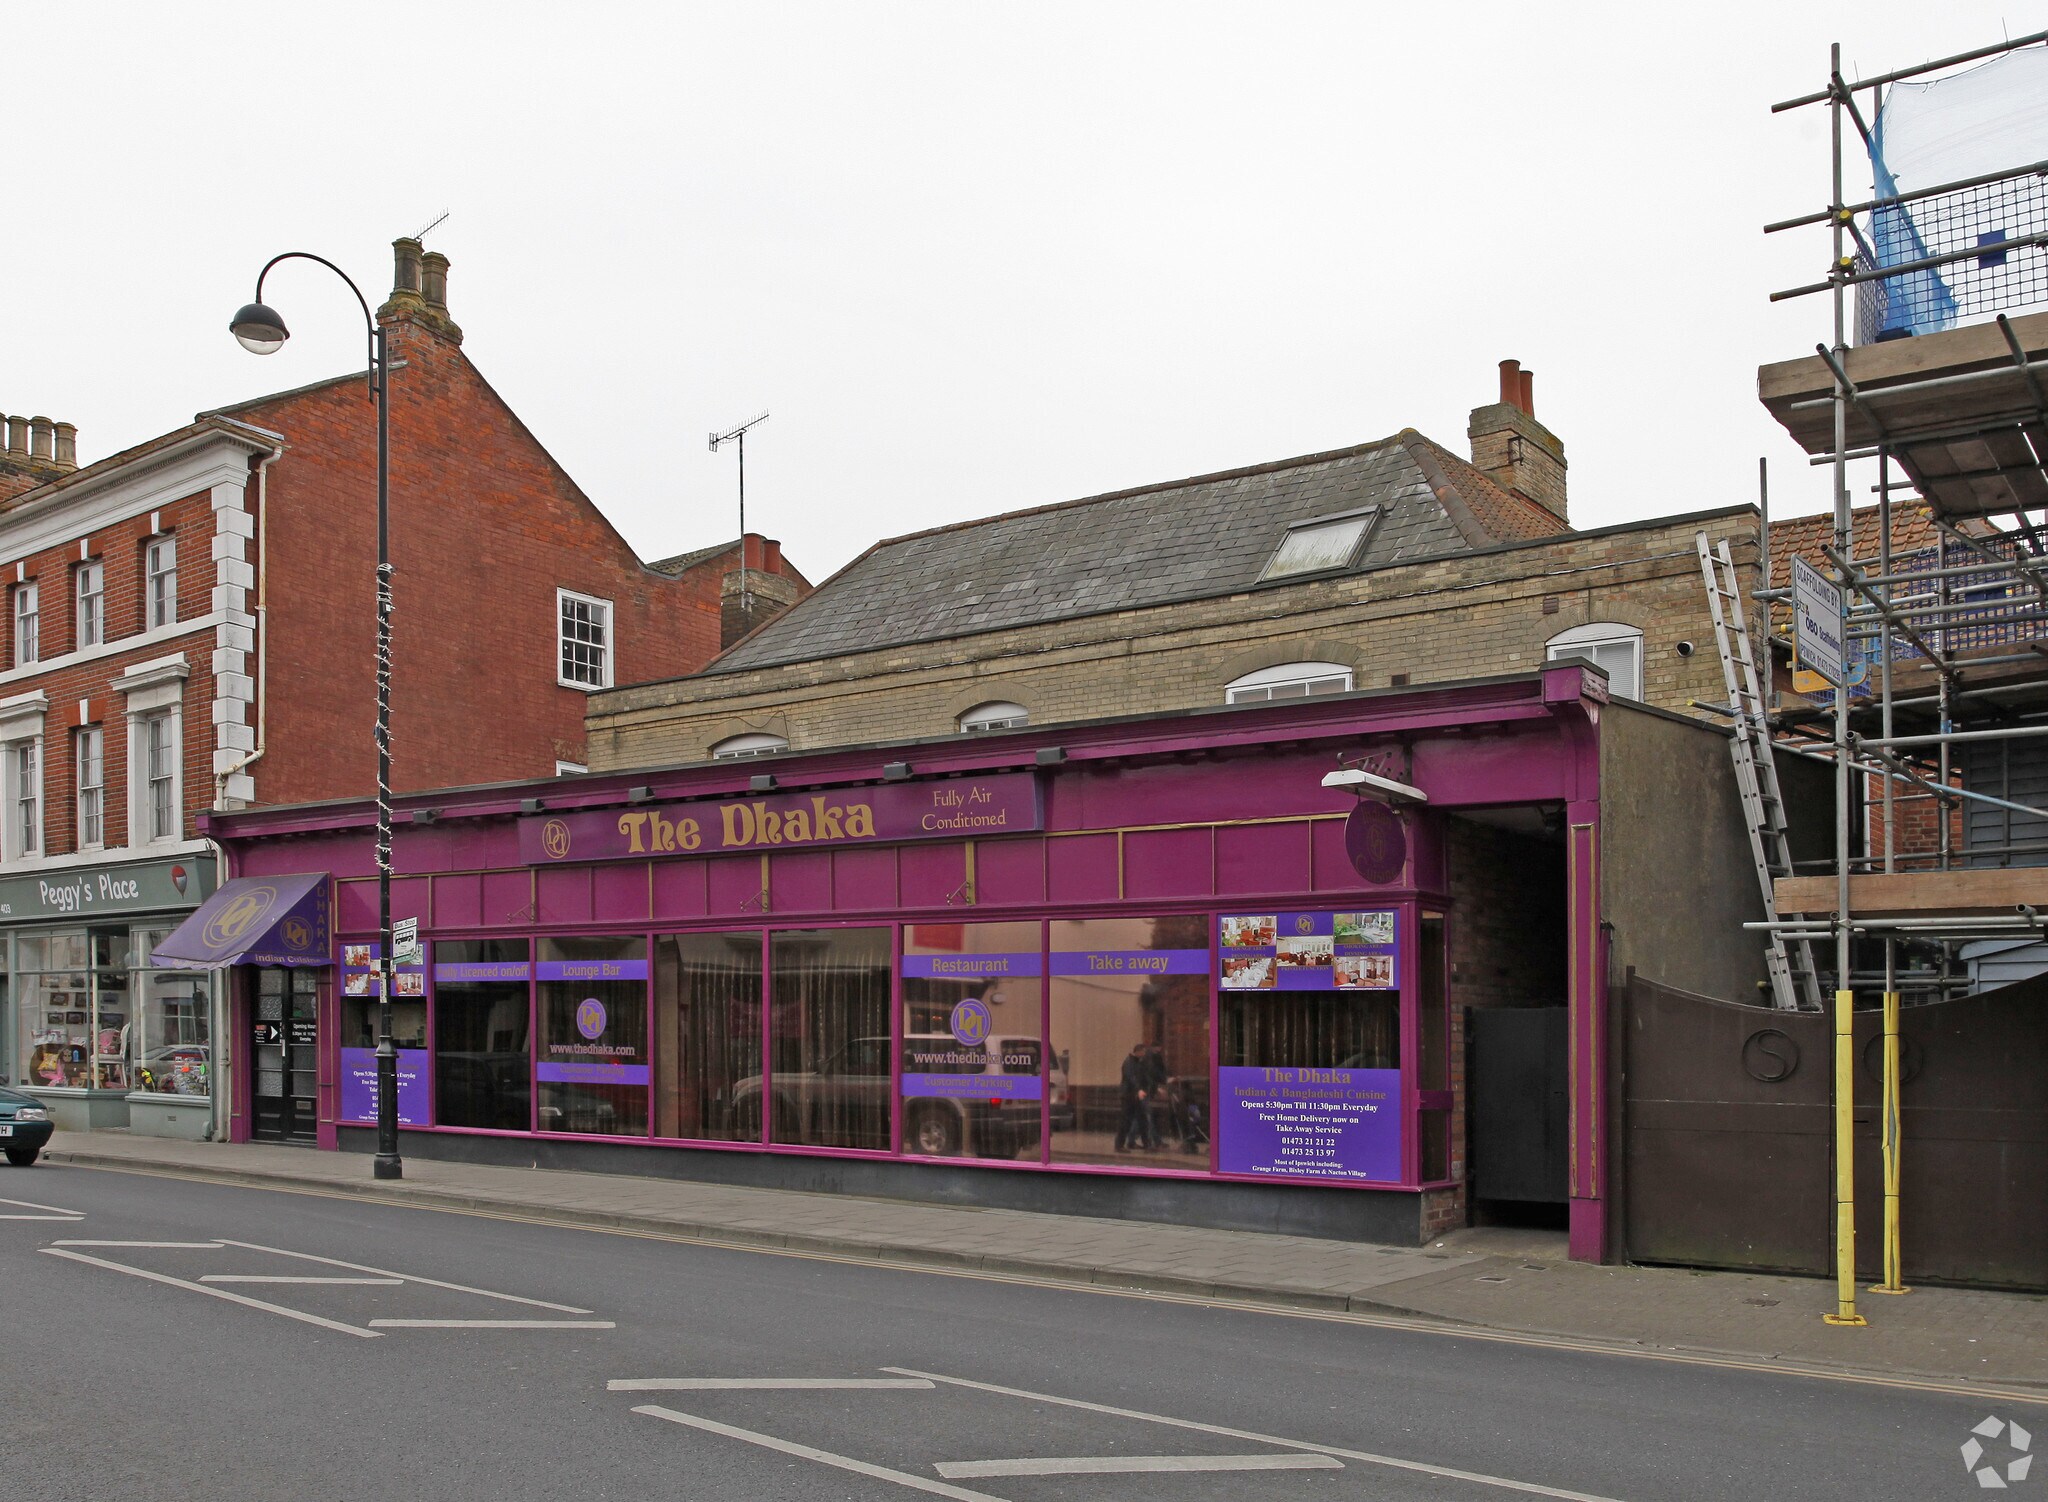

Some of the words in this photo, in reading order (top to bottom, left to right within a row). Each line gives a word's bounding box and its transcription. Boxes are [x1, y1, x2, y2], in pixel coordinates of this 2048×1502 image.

[1797, 565, 1831, 603] SCAFFOLDING
[933, 789, 963, 808] Fully
[968, 786, 992, 805] Air
[618, 810, 702, 853] The
[719, 796, 876, 848] Dhaka
[921, 809, 1007, 831] Conditioned
[40, 876, 93, 911] Peggy's
[99, 873, 139, 900] Place
[1, 904, 11, 914] 403
[316, 886, 326, 953] DHAKA
[461, 965, 498, 977] Licenced
[501, 964, 529, 977] on/off
[563, 964, 599, 979] Lounge
[602, 963, 621, 976] Bar
[932, 958, 1009, 972] Restaurant
[1088, 955, 1123, 970] Take
[1129, 957, 1168, 973] away
[550, 1044, 636, 1056] www.thedhaka.com
[914, 1051, 1032, 1066] www.thedhaka.com
[925, 1075, 971, 1088] Customer
[974, 1077, 1013, 1091] Parking
[1261, 1067, 1292, 1082] The
[1298, 1069, 1352, 1084] Dhaka
[1234, 1087, 1267, 1097] Indian
[1269, 1088, 1279, 1097] &
[1282, 1088, 1344, 1101] Bangladeshi
[1346, 1090, 1387, 1100] Cuisine
[1241, 1100, 1264, 1110] Opens
[1265, 1101, 1293, 1110] 5:30pm
[1294, 1101, 1307, 1110] Till
[1309, 1102, 1341, 1111] 11:30pm
[1342, 1103, 1379, 1113] Everyday
[1259, 1113, 1275, 1121] Free
[1277, 1113, 1298, 1122] Home
[1300, 1114, 1331, 1124] Delivery
[1275, 1124, 1293, 1132] Take
[1294, 1125, 1314, 1134] Away
[1315, 1125, 1343, 1134] Service
[1281, 1136, 1303, 1145] 01473
[1305, 1137, 1314, 1145] 21
[1316, 1138, 1324, 1146] 21
[1326, 1138, 1335, 1146] 22
[1281, 1147, 1303, 1156] 01473
[1305, 1148, 1314, 1156] 25
[1316, 1148, 1325, 1156] 13
[1326, 1149, 1335, 1157] 97
